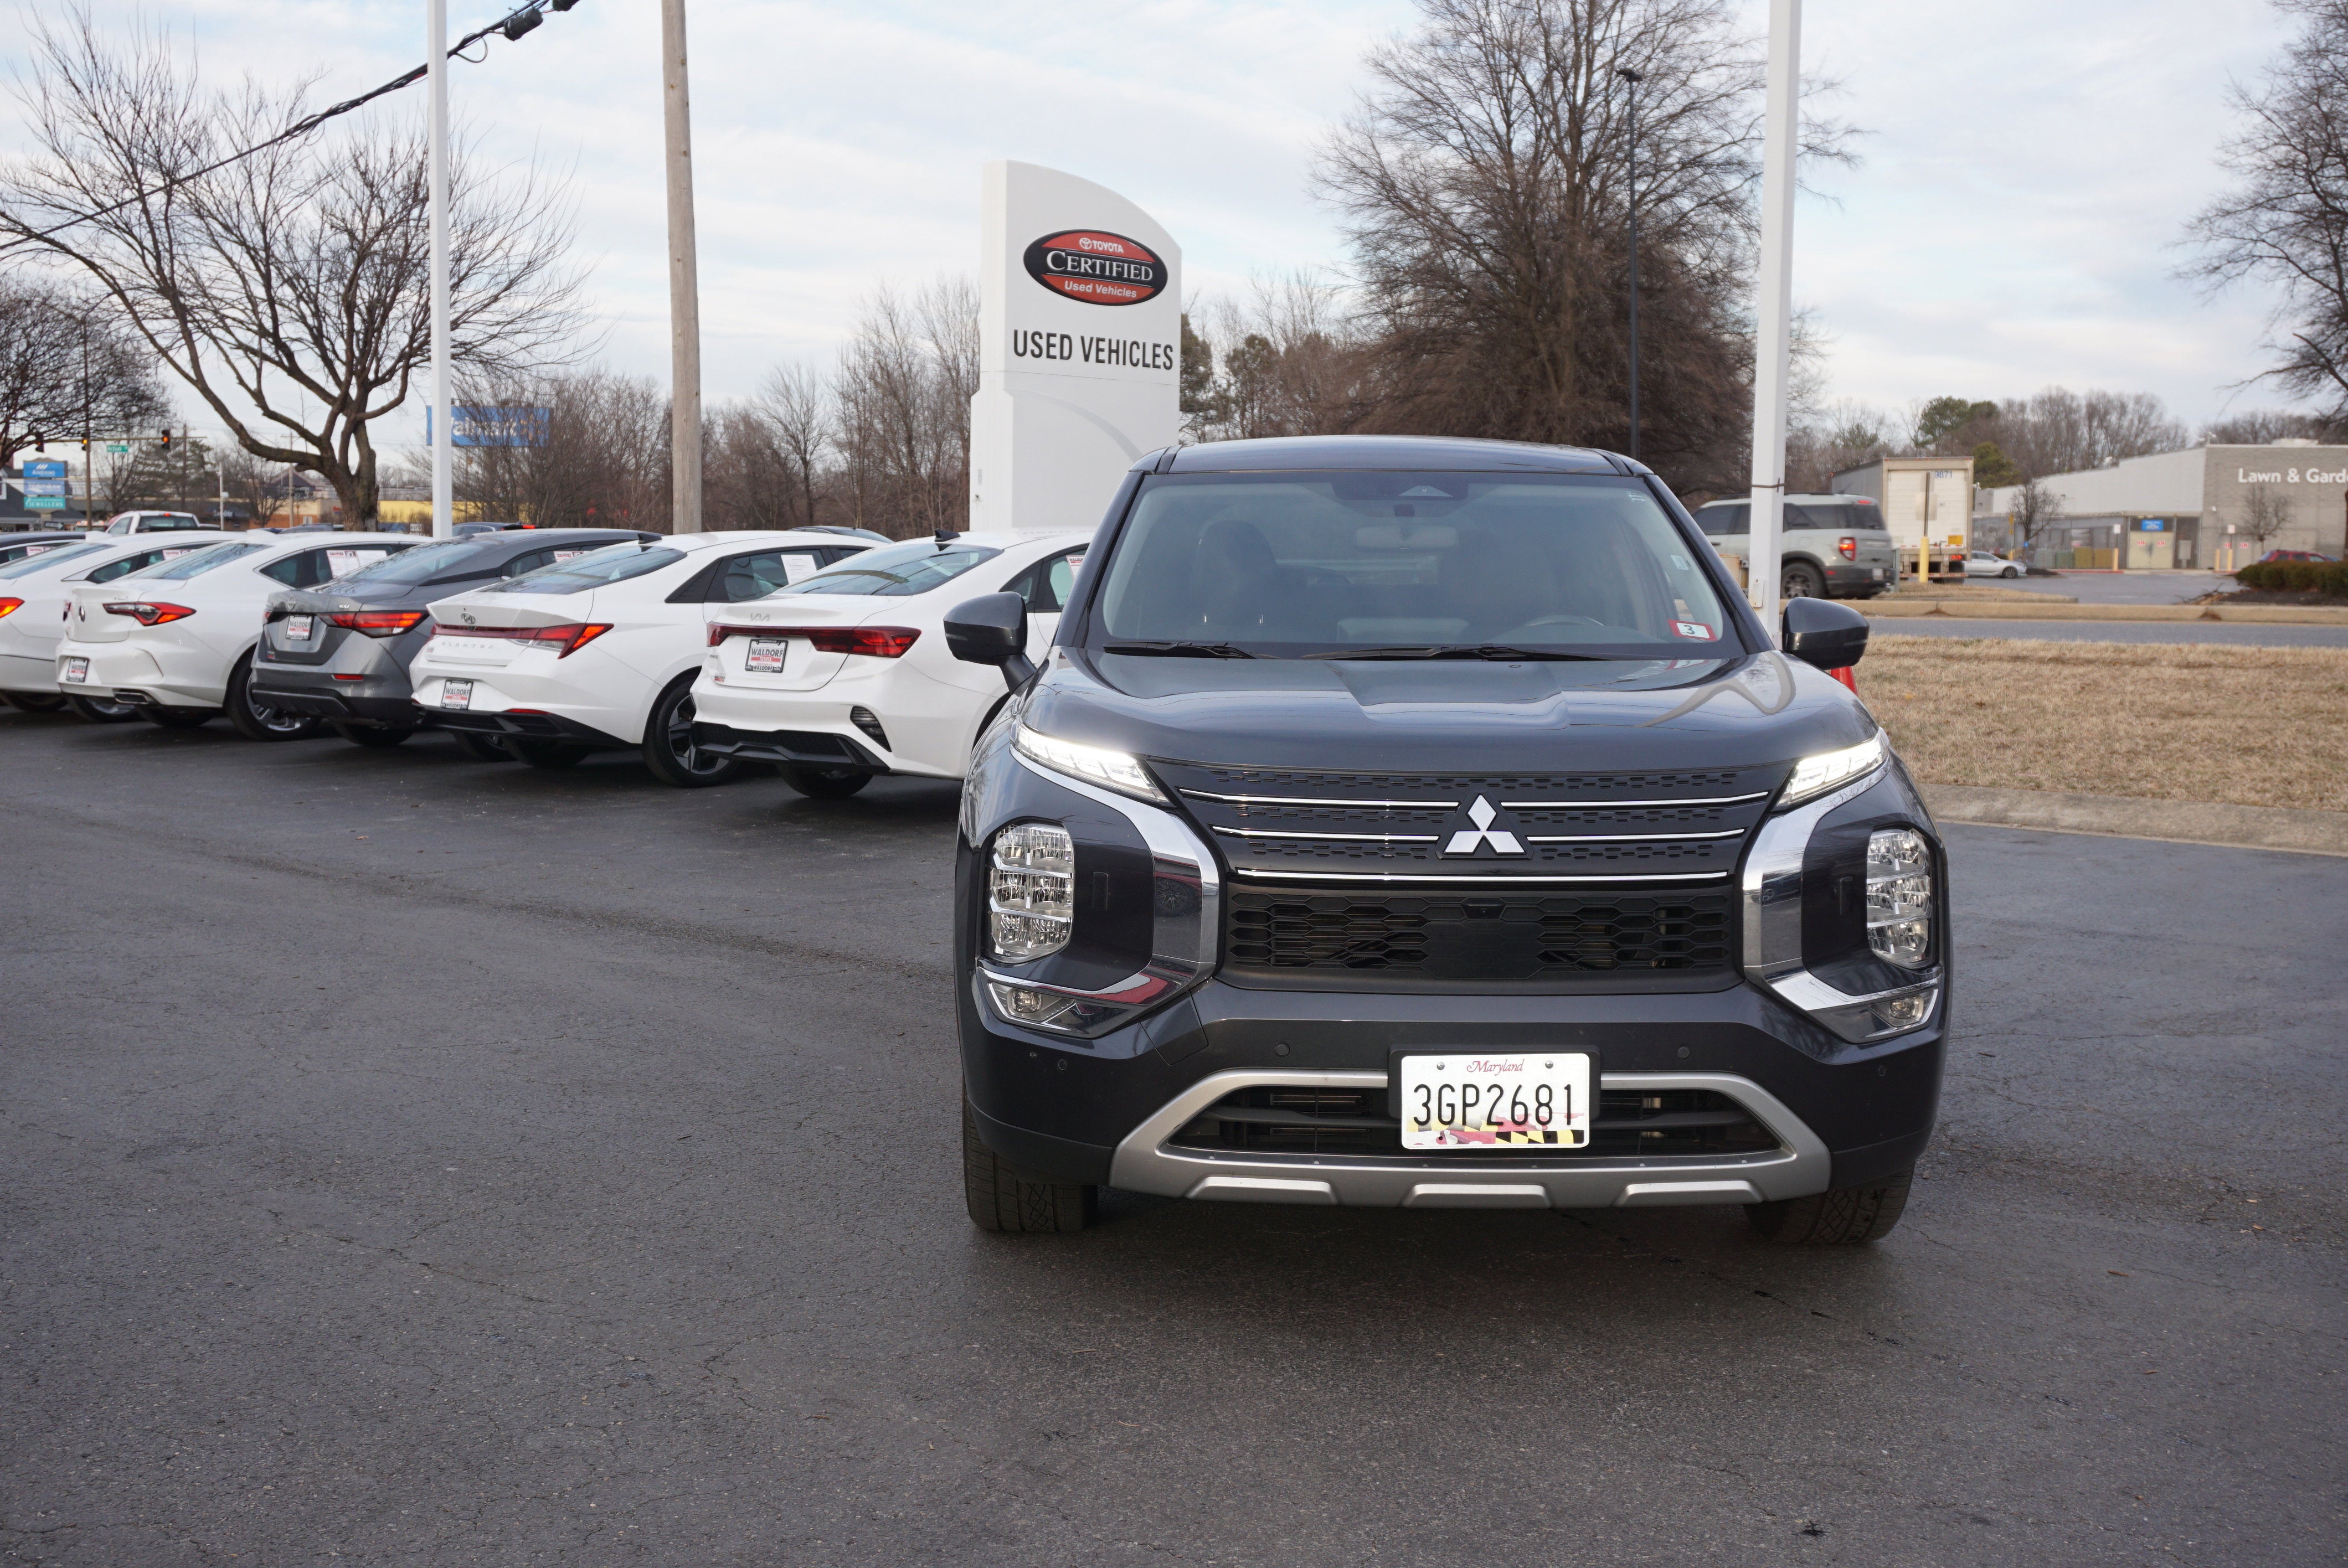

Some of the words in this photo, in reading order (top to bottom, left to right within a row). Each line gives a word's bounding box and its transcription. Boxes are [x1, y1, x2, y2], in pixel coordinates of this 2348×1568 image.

[1092, 240, 1124, 253] TOYOTA
[1046, 251, 1153, 281] CERTIFIED
[1064, 280, 1093, 293] Used
[1096, 284, 1137, 298] Vehicles
[1013, 329, 1073, 360] USED
[1080, 335, 1173, 370] VEHICLES
[2238, 467, 2281, 483] Lawn
[2287, 467, 2300, 483] &
[2305, 467, 2348, 483] Gard
[1684, 625, 1695, 635] 3
[751, 648, 783, 657] WALDORF
[446, 688, 470, 696] WALDORF
[1466, 1059, 1525, 1076] Maryland
[1413, 1084, 1572, 1126] 3GP2681
